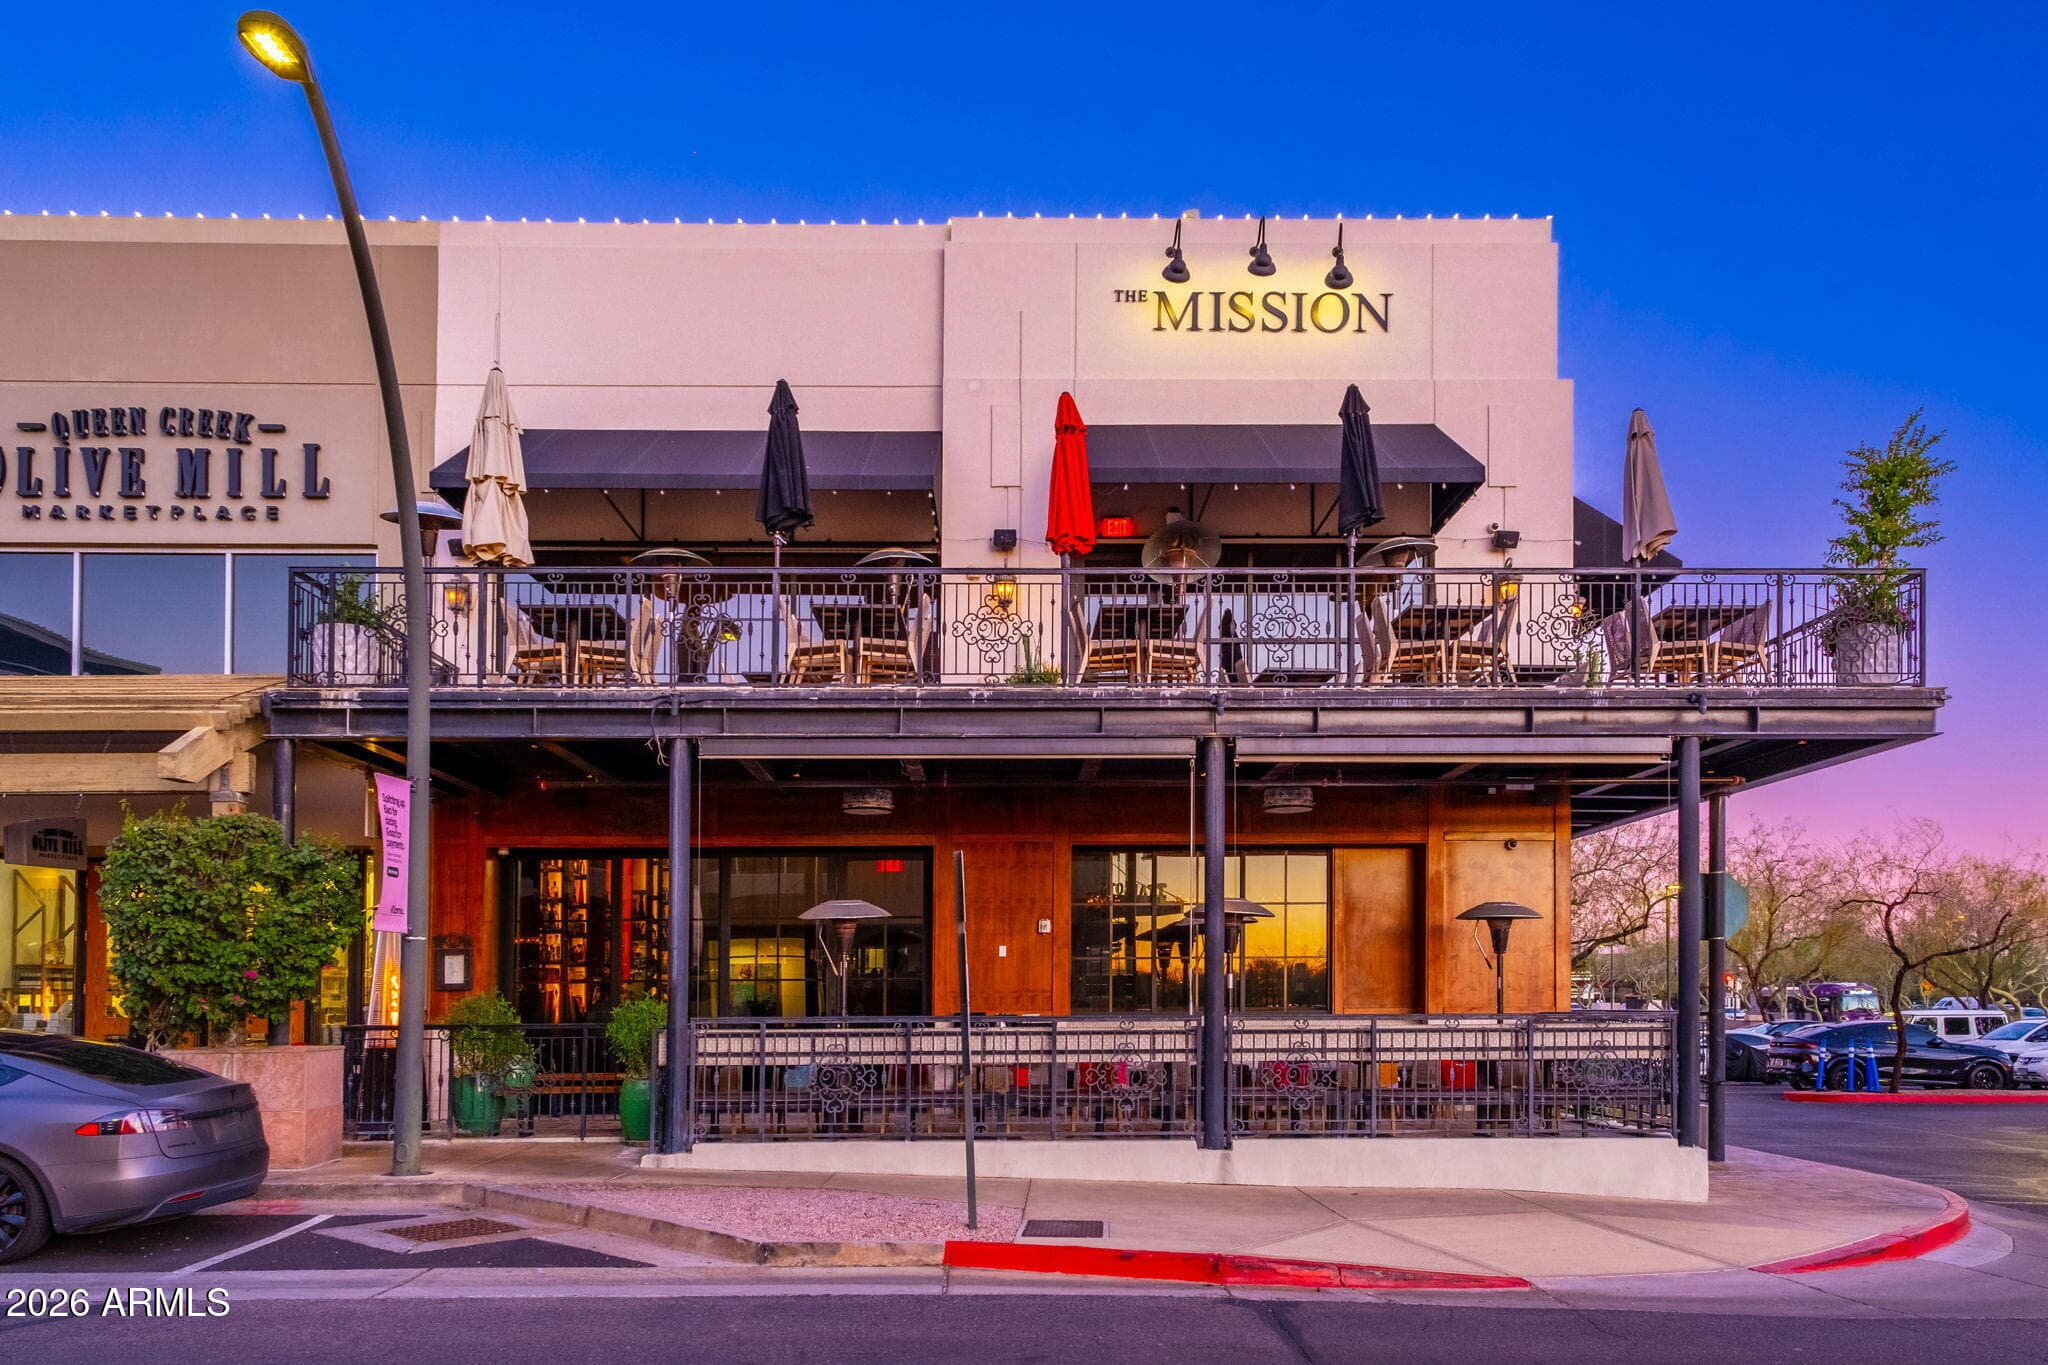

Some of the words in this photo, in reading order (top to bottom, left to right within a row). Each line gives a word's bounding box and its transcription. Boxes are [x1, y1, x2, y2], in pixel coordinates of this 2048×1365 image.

[1114, 289, 1148, 303] THE
[1152, 290, 1394, 334] MISSION
[51, 406, 147, 446] QUEEN
[159, 406, 255, 444] CREEK
[0, 446, 146, 498] LIVE
[175, 443, 330, 499] MILL
[22, 504, 280, 521] MARKETPLACE
[1107, 519, 1128, 535] EXIT
